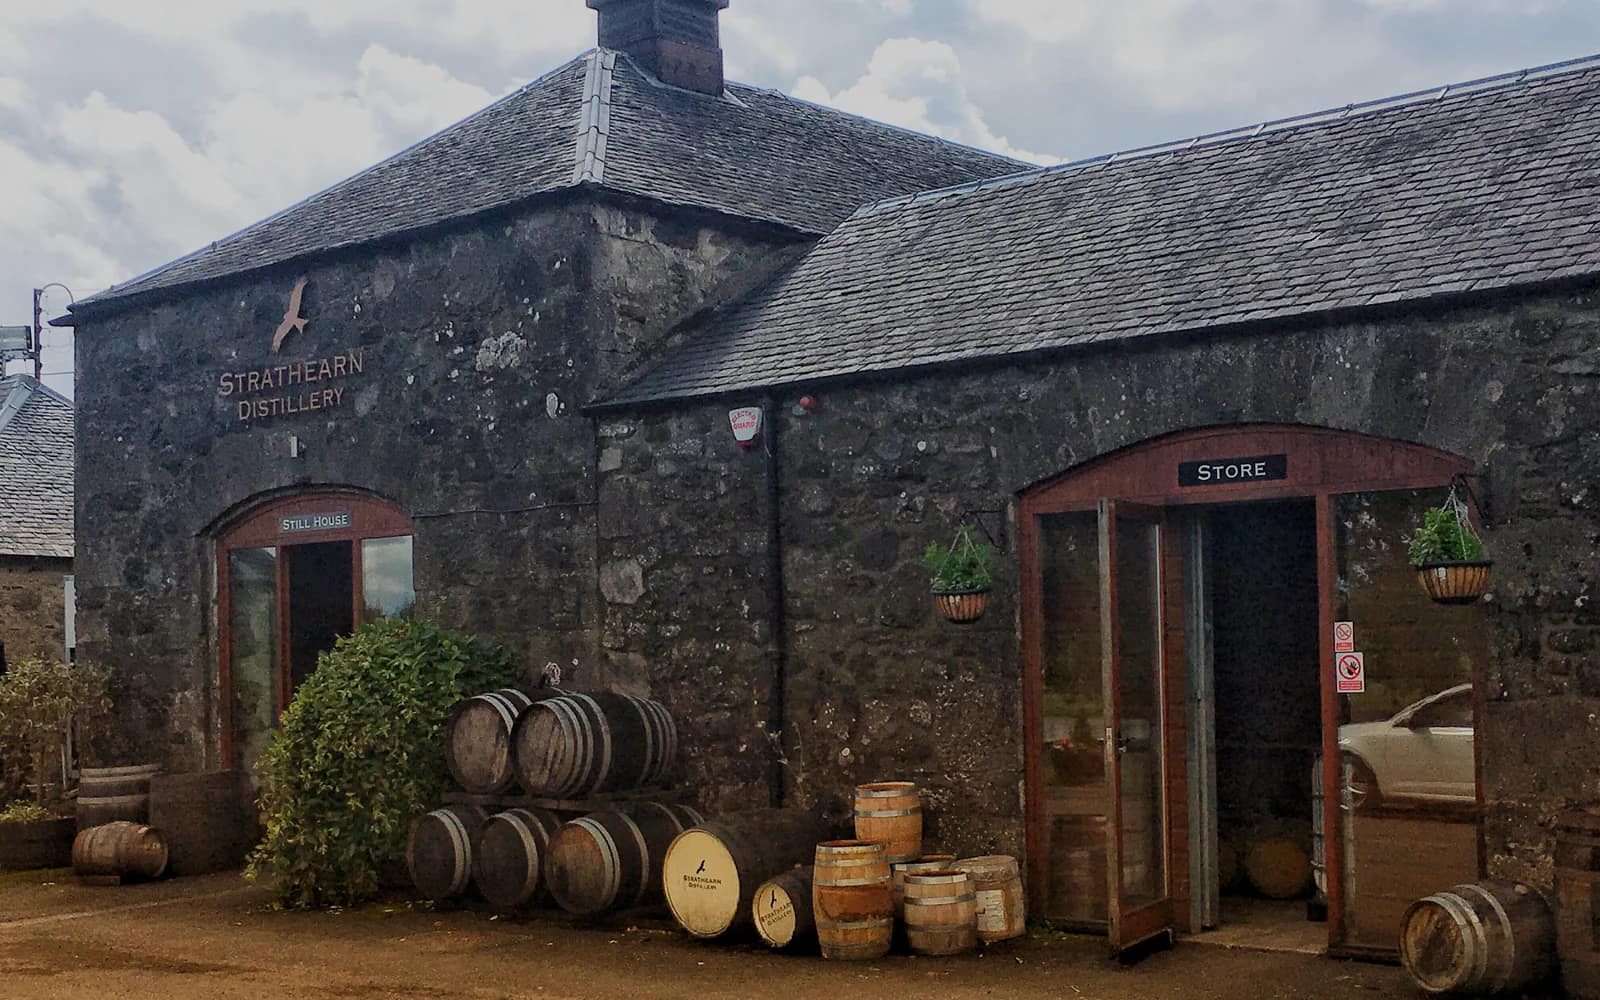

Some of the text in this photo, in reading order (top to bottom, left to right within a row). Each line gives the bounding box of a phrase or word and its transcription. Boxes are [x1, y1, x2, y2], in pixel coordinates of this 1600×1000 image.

[219, 351, 363, 396] STRATHEARN
[239, 387, 344, 420] DISTILLERY
[1198, 461, 1266, 481] STORE
[283, 515, 348, 530] STILL HOUSE
